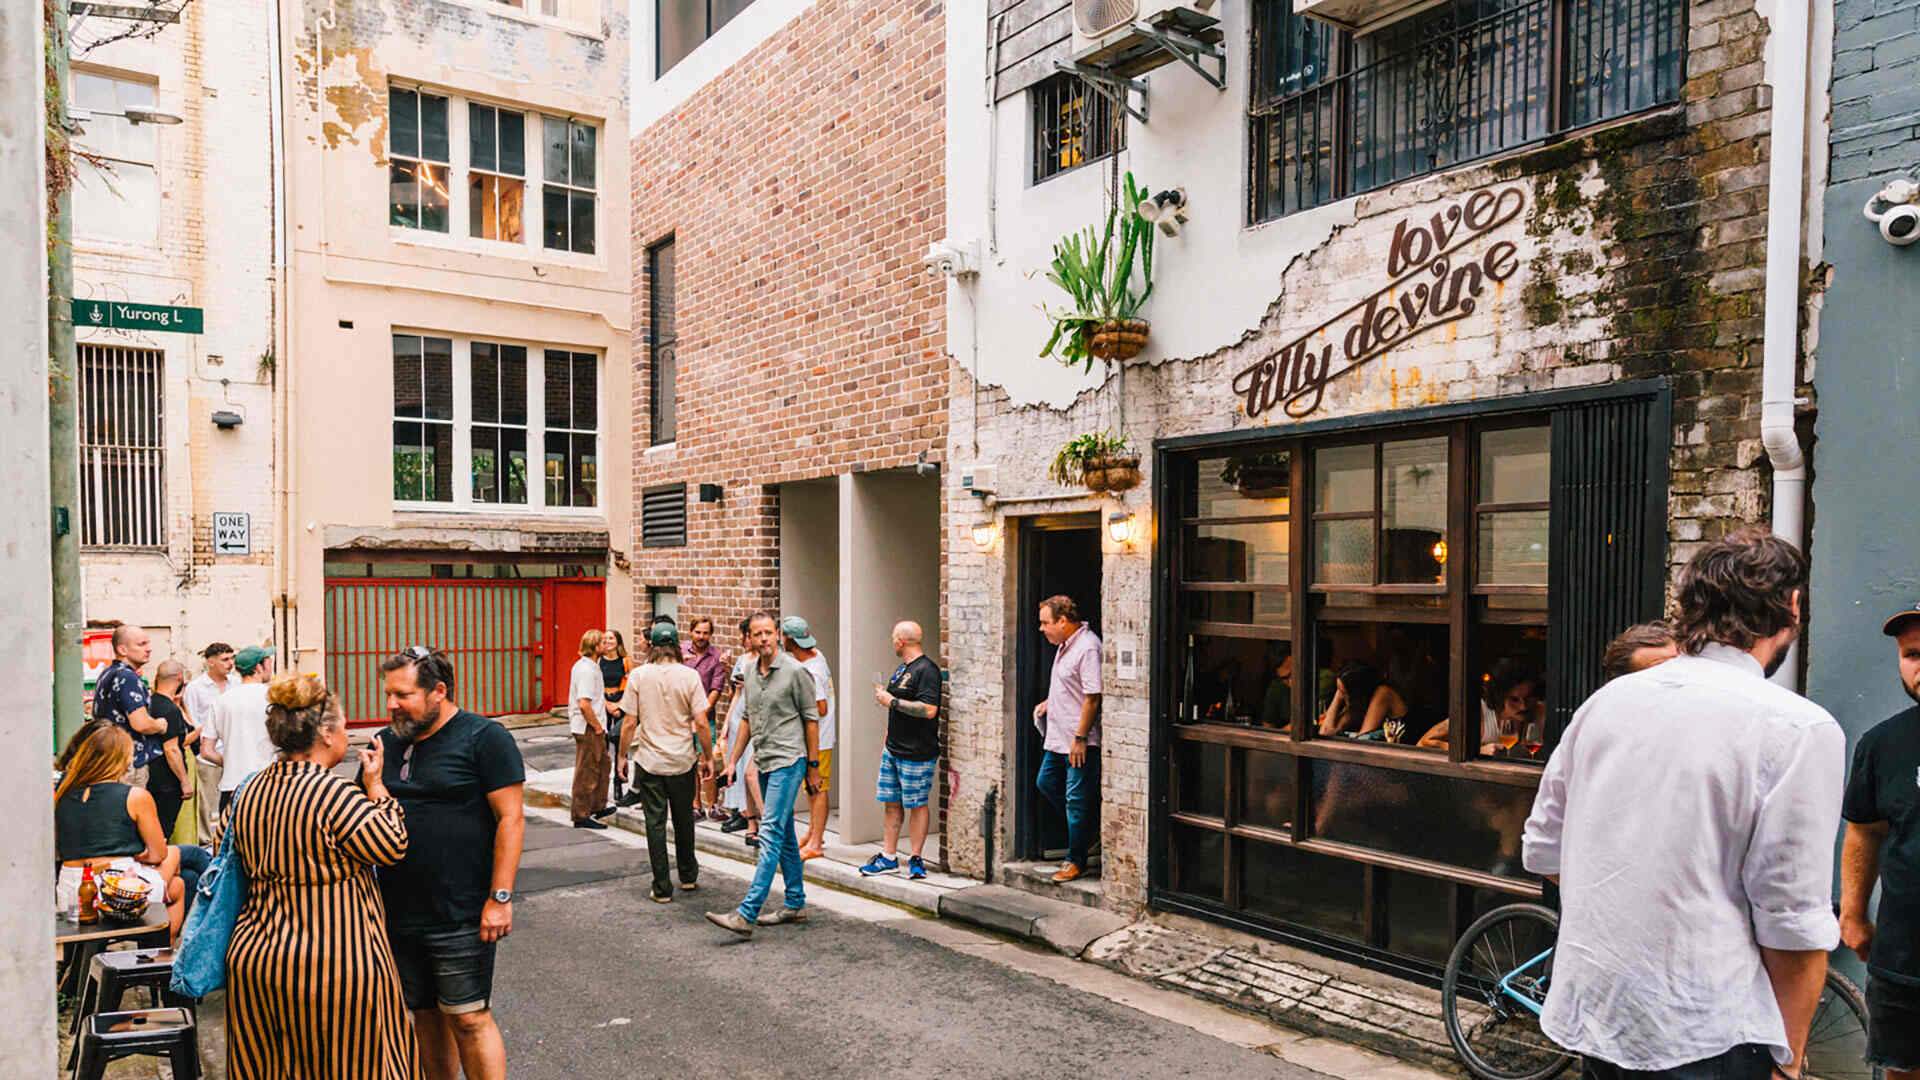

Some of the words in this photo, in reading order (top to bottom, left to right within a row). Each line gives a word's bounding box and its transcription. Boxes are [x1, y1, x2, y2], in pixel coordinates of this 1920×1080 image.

[1387, 187, 1524, 278] love
[117, 305, 169, 326] Yurong
[173, 309, 183, 323] L
[1232, 340, 1333, 418] tilly
[1344, 240, 1520, 361] devine
[219, 516, 245, 527] ONE
[218, 530, 245, 540] WAY
